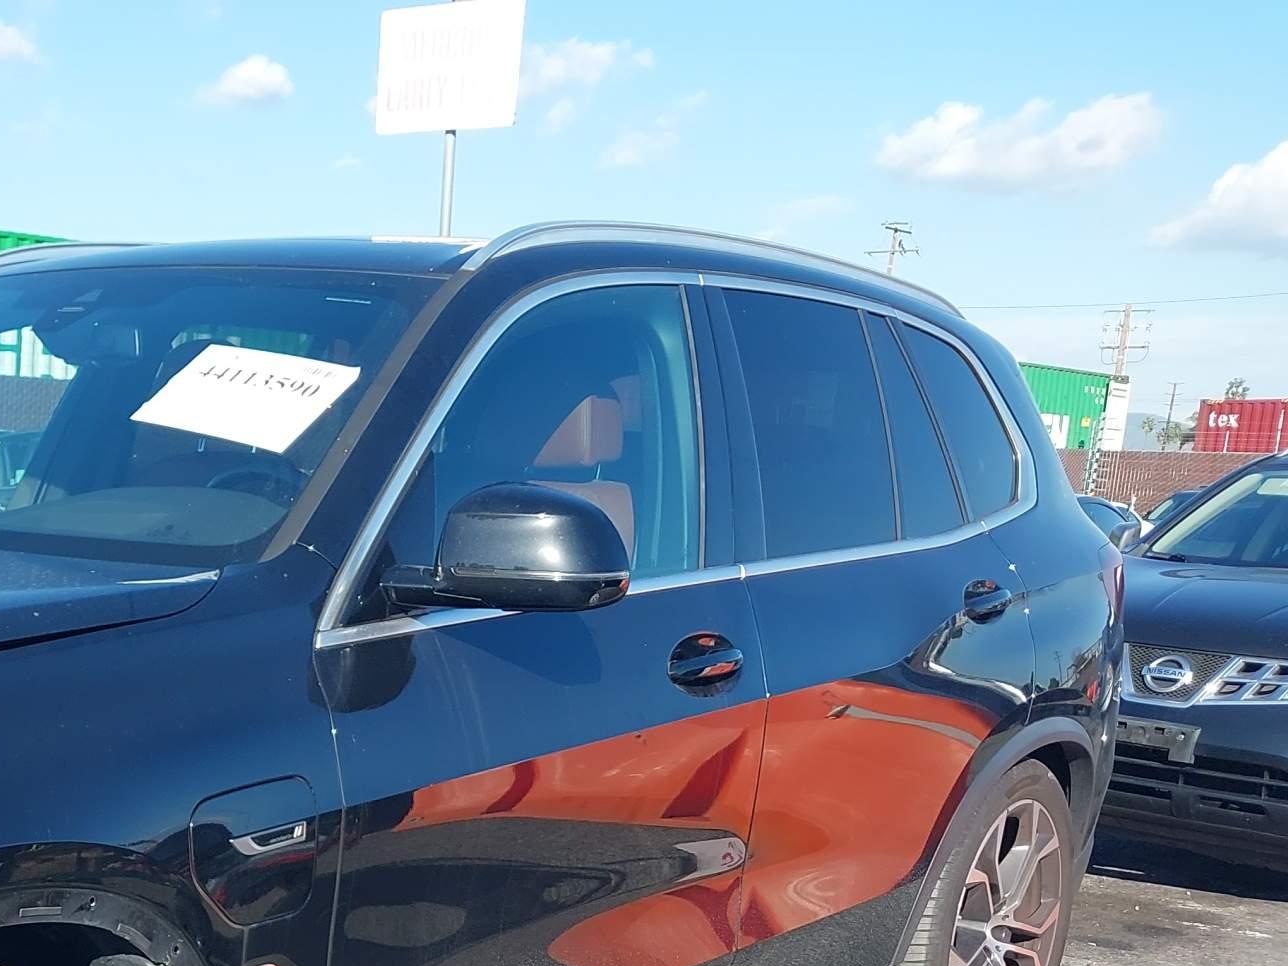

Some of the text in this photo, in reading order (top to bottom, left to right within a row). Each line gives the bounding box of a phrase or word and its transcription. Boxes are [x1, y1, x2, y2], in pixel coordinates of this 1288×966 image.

[198, 365, 321, 397] 44113590
[1208, 411, 1240, 428] tex
[1146, 667, 1187, 678] NISSAN
